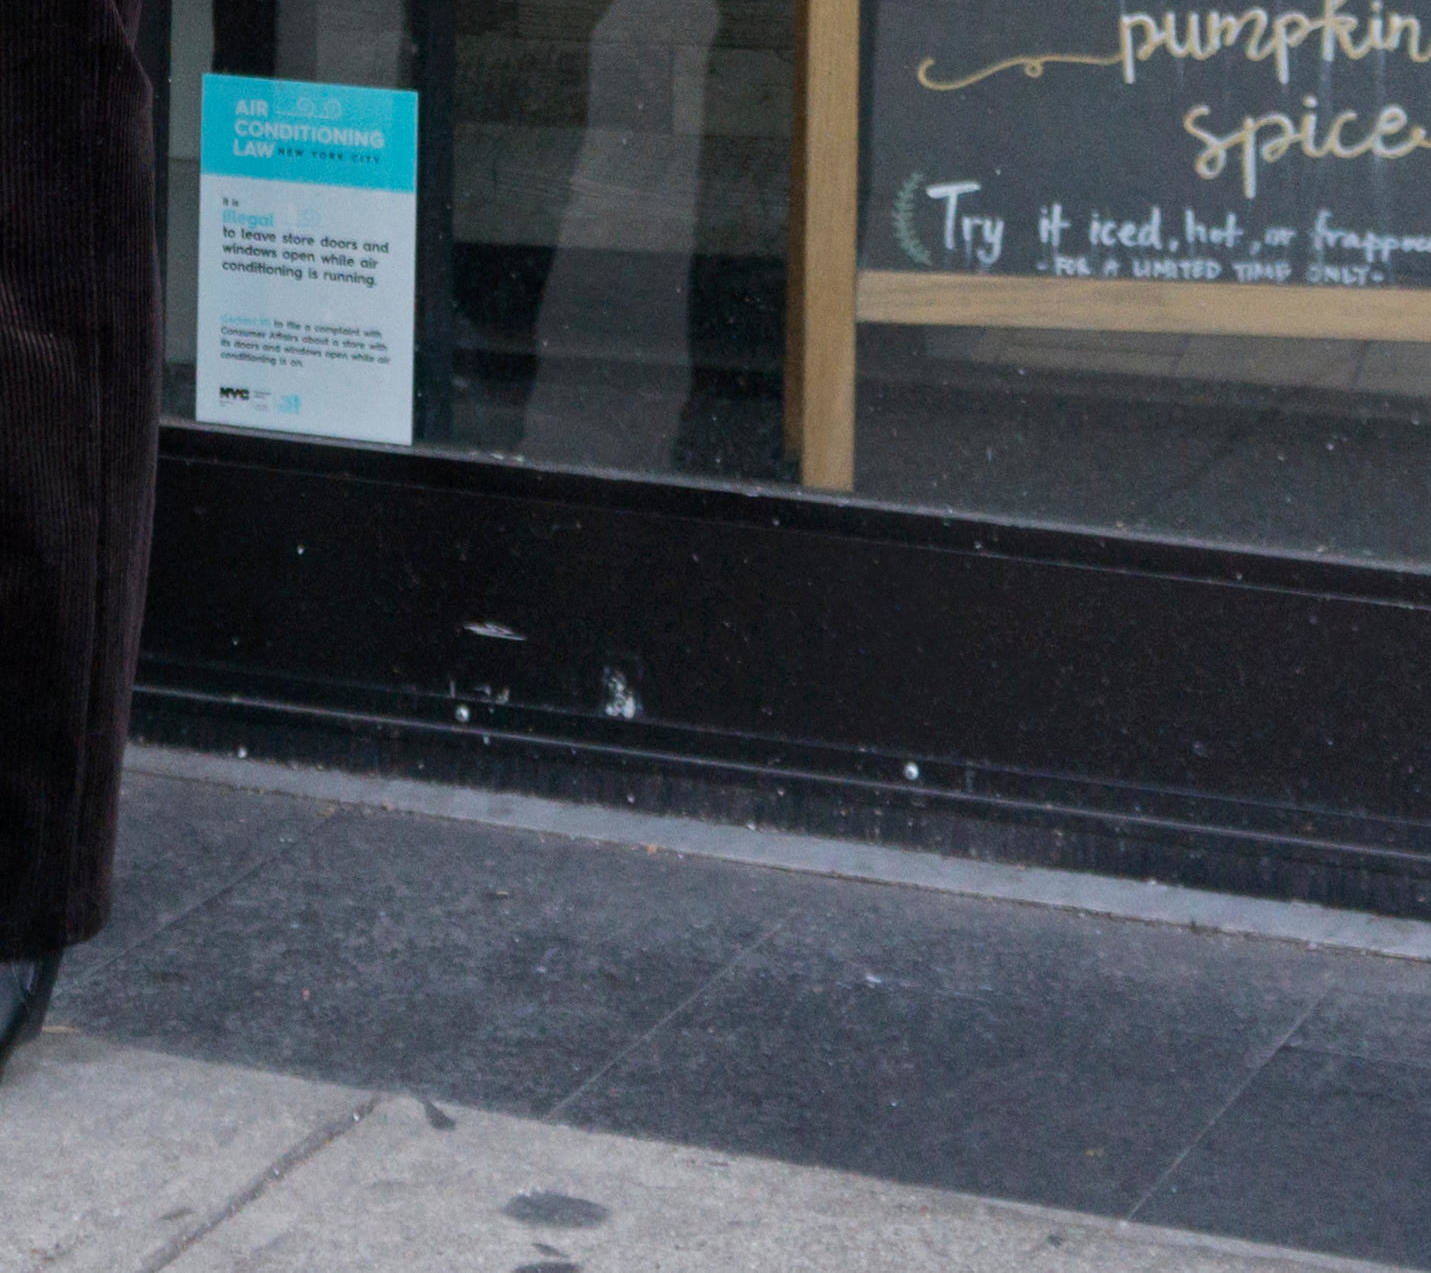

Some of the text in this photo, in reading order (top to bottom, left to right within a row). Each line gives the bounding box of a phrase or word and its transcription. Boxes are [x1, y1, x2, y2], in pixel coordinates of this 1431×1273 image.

[235, 99, 269, 117] AIR
[234, 119, 385, 149] CONDITIONING
[1183, 95, 1426, 200] spice
[233, 139, 380, 165] LAW NEW YORK CITY
[925, 180, 1005, 264] Try
[1038, 203, 1071, 247] it
[222, 226, 390, 254] to leave store doors and
[222, 242, 379, 270] windows open while air
[222, 258, 377, 288] conditioning is running.
[1231, 261, 1292, 283] TIME
[219, 385, 251, 402] NYC
